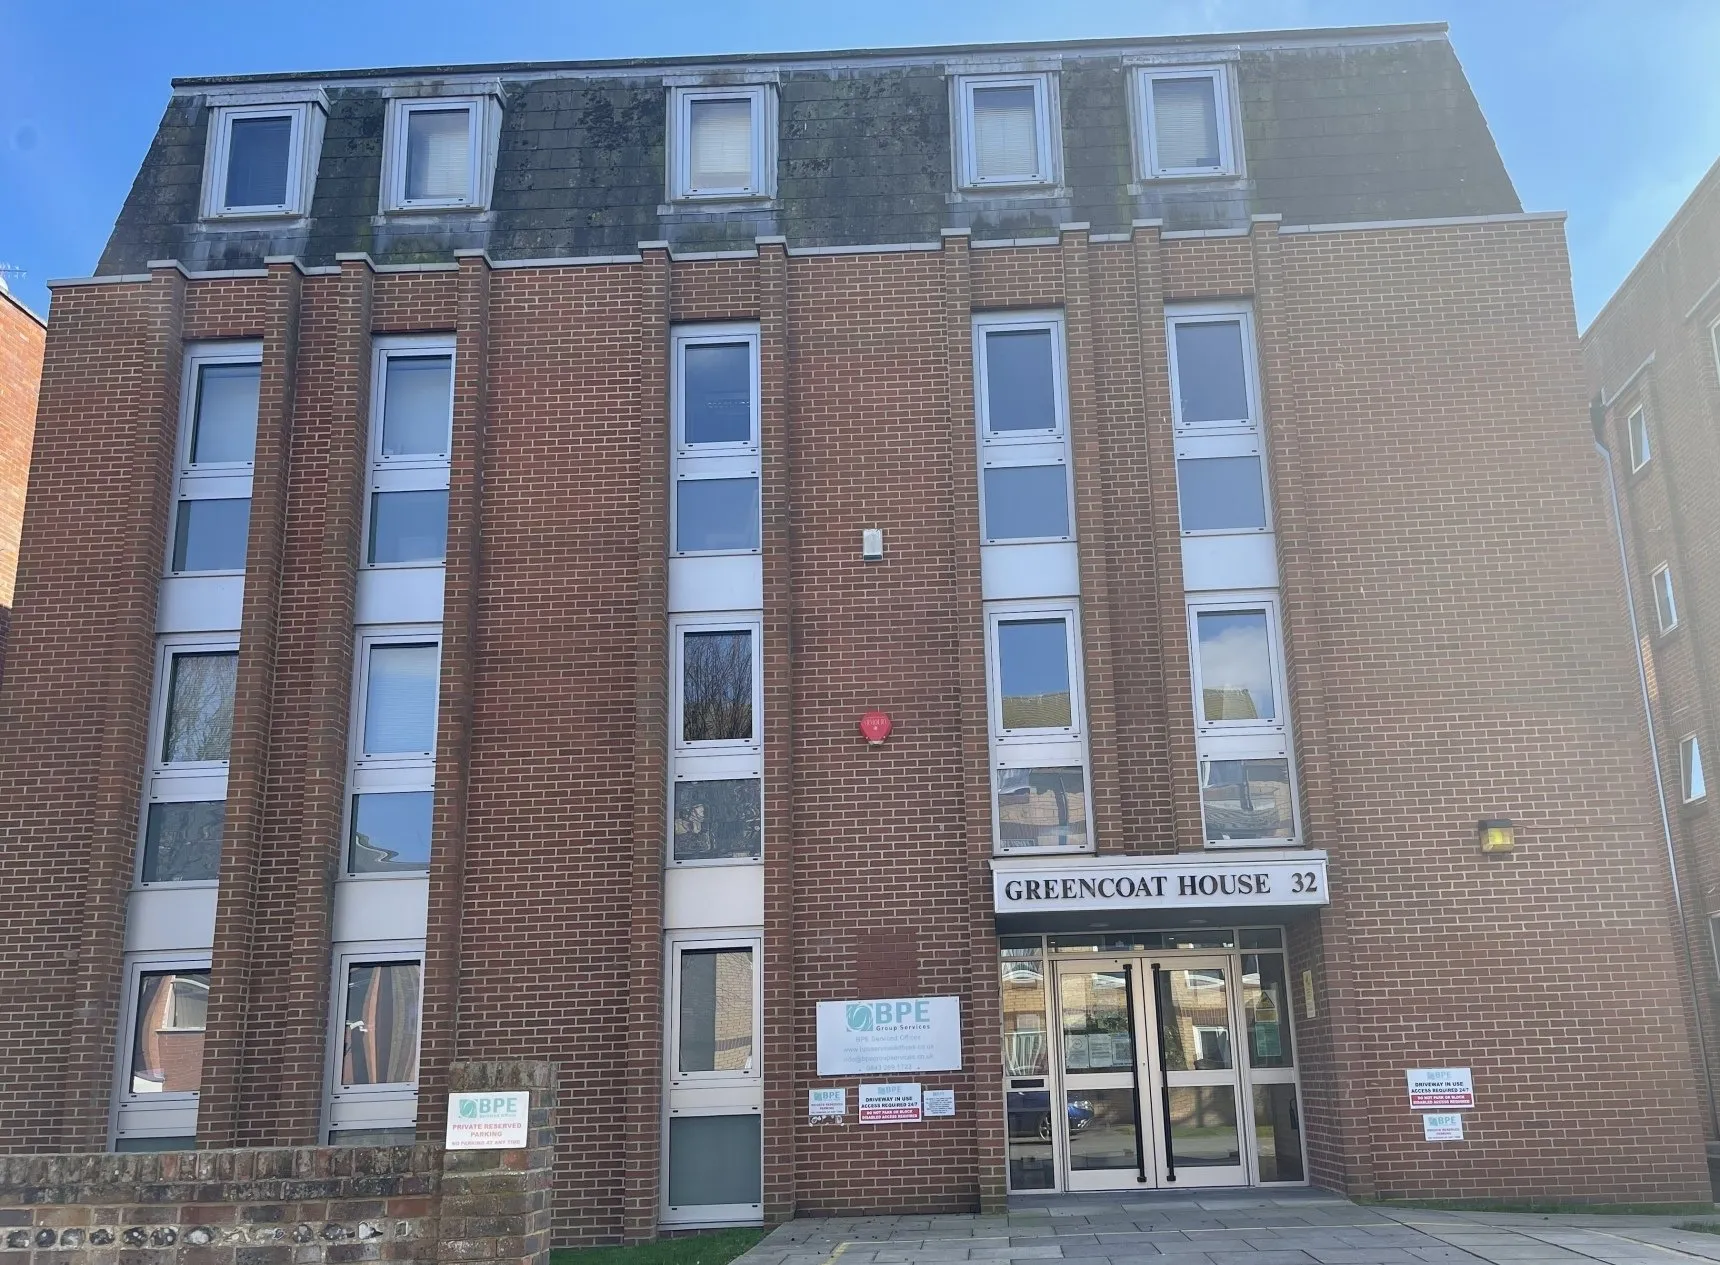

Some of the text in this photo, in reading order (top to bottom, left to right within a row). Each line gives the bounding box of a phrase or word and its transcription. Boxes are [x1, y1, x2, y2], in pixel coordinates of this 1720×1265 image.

[1005, 871, 1318, 901] GREENCOAT HOUSE 32
[875, 1000, 930, 1024] BPE
[822, 1091, 840, 1099] BPE
[479, 1097, 517, 1113] BPE
[1438, 1116, 1456, 1124] BPE
